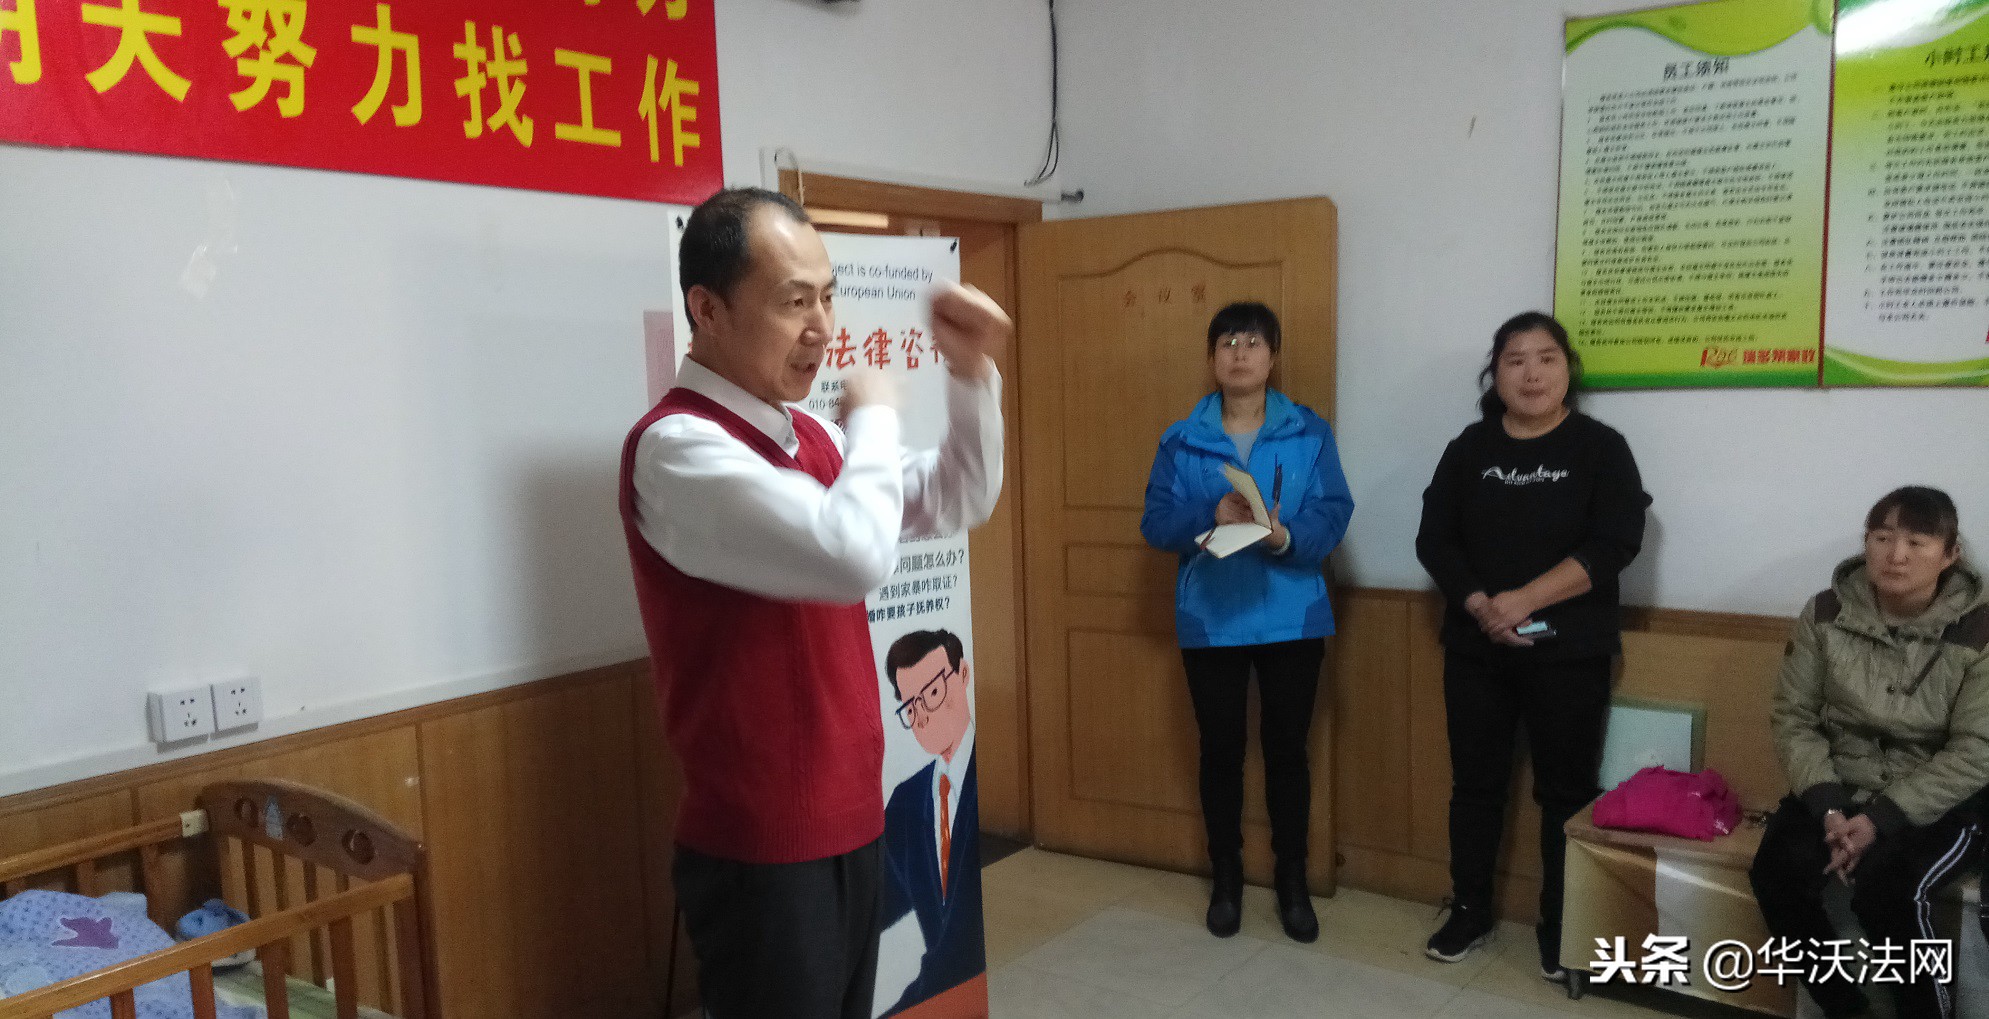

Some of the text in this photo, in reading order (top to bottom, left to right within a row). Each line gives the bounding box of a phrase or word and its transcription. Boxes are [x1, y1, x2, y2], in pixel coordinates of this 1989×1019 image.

[857, 263, 866, 277] is
[921, 267, 933, 283] by
[835, 285, 916, 301] uropean Union
[826, 327, 944, 371] 法律咨
[893, 548, 965, 574] 问题怎么办？
